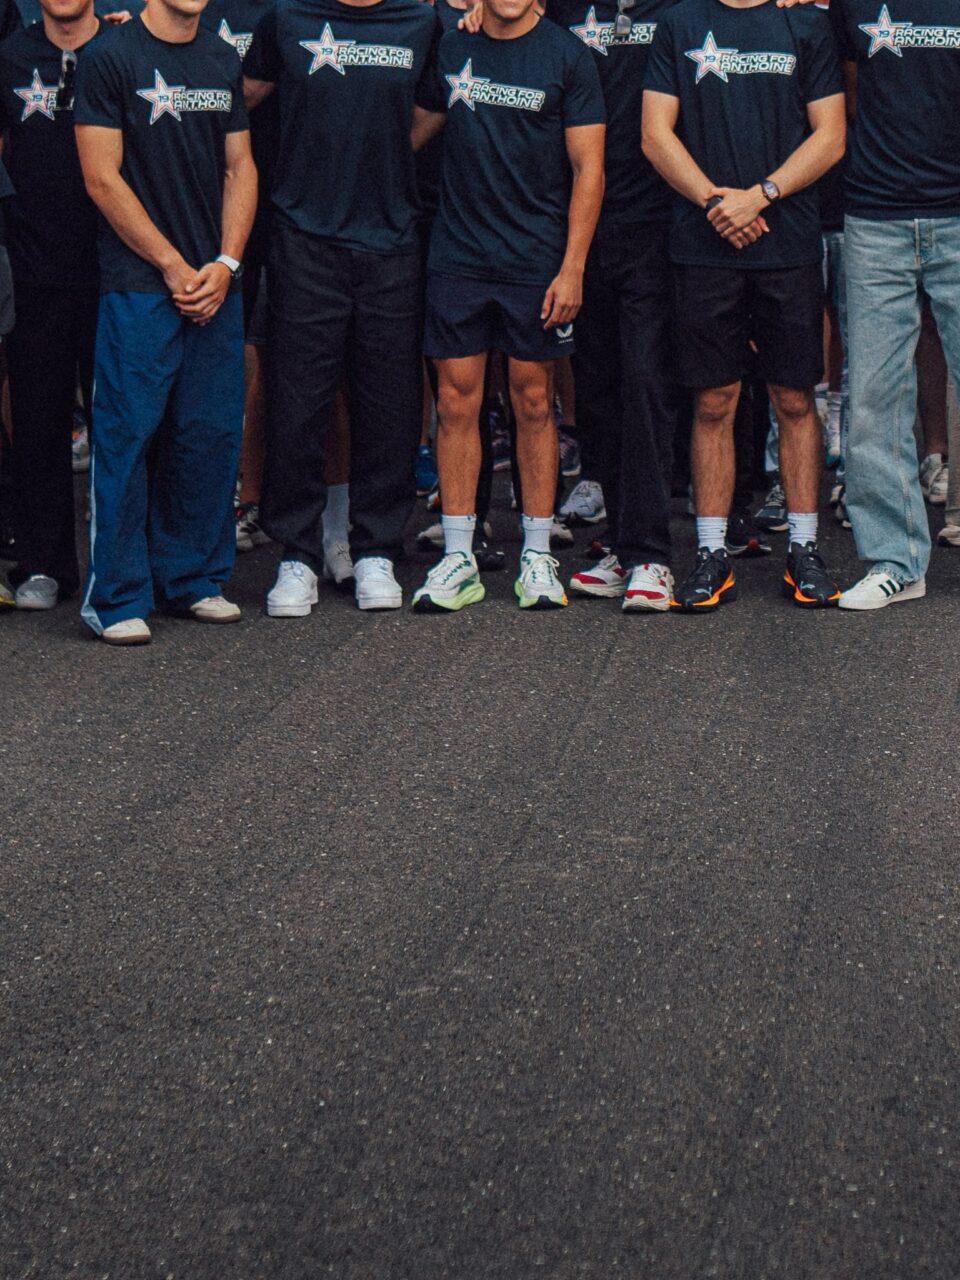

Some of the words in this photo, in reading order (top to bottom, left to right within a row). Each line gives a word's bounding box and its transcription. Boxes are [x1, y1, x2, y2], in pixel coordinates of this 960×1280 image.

[895, 28, 944, 37] RACING
[946, 29, 960, 38] FO
[894, 36, 960, 46] ANTHOIN
[321, 47, 333, 56] 19
[338, 46, 387, 57] RACING
[389, 48, 412, 59] FOR
[337, 54, 411, 67] ANTHOINE
[721, 54, 768, 64] RACING
[720, 62, 792, 73] ANTHOINE
[174, 91, 214, 101] RACING
[472, 83, 517, 97] RACING
[518, 89, 543, 101] FOR
[470, 90, 541, 109] ANTHOINE
